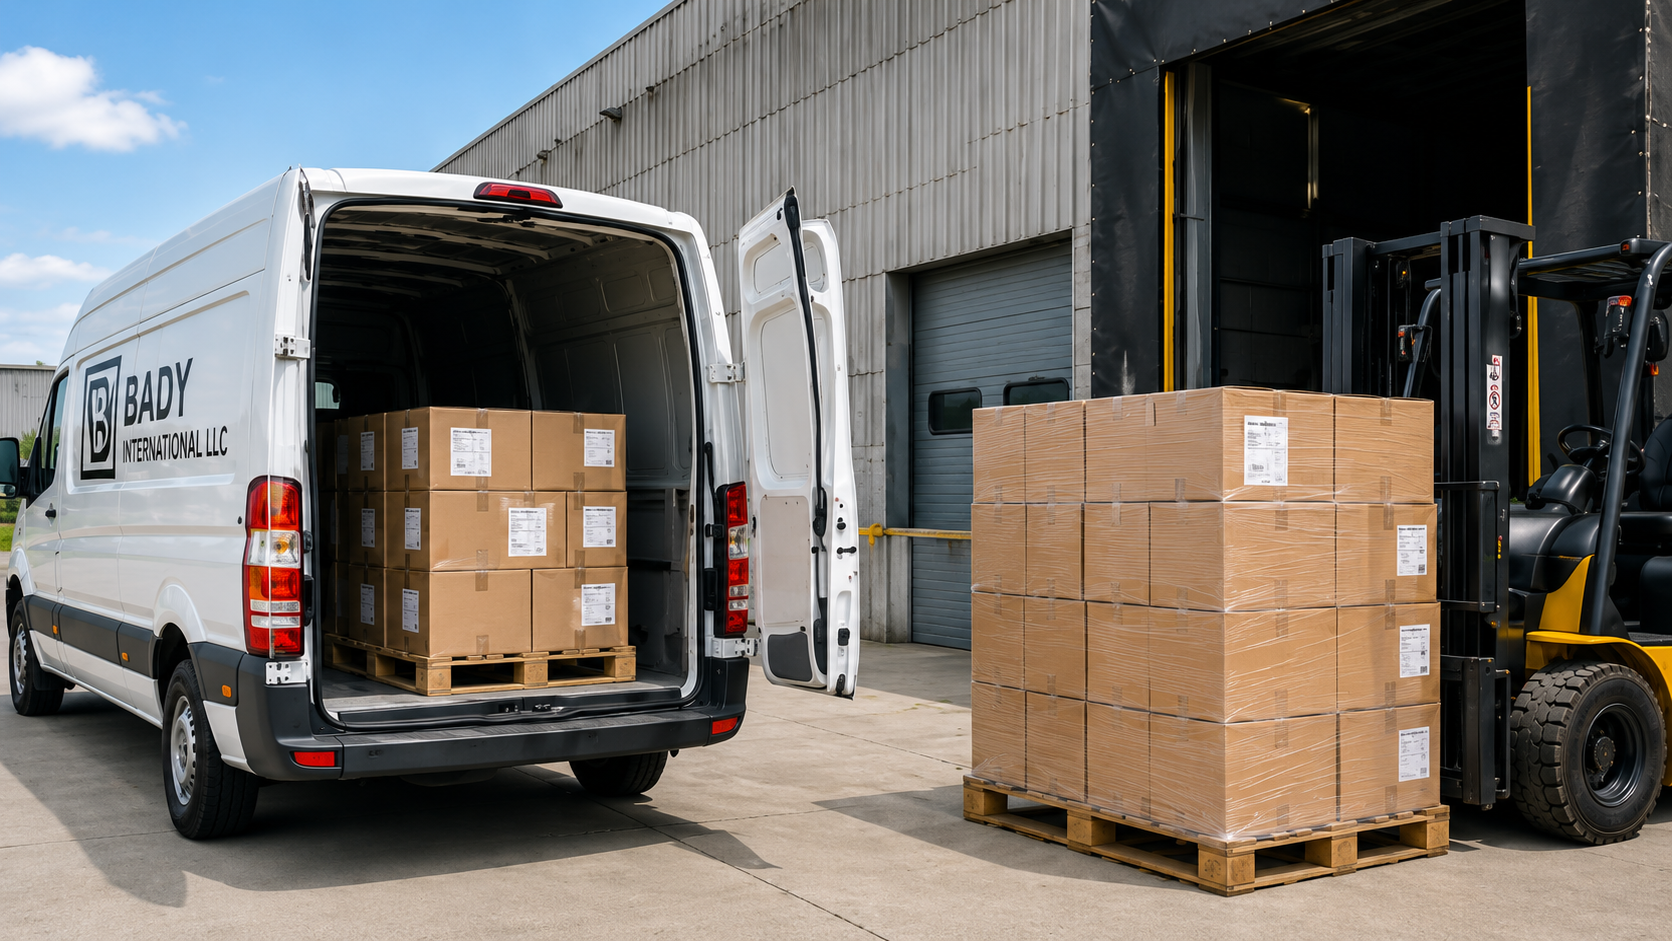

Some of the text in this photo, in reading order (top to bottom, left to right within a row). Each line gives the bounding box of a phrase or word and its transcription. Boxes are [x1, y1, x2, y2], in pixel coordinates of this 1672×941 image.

[124, 357, 193, 427] BADY
[123, 425, 228, 463] INTERNATIONAL LLC
